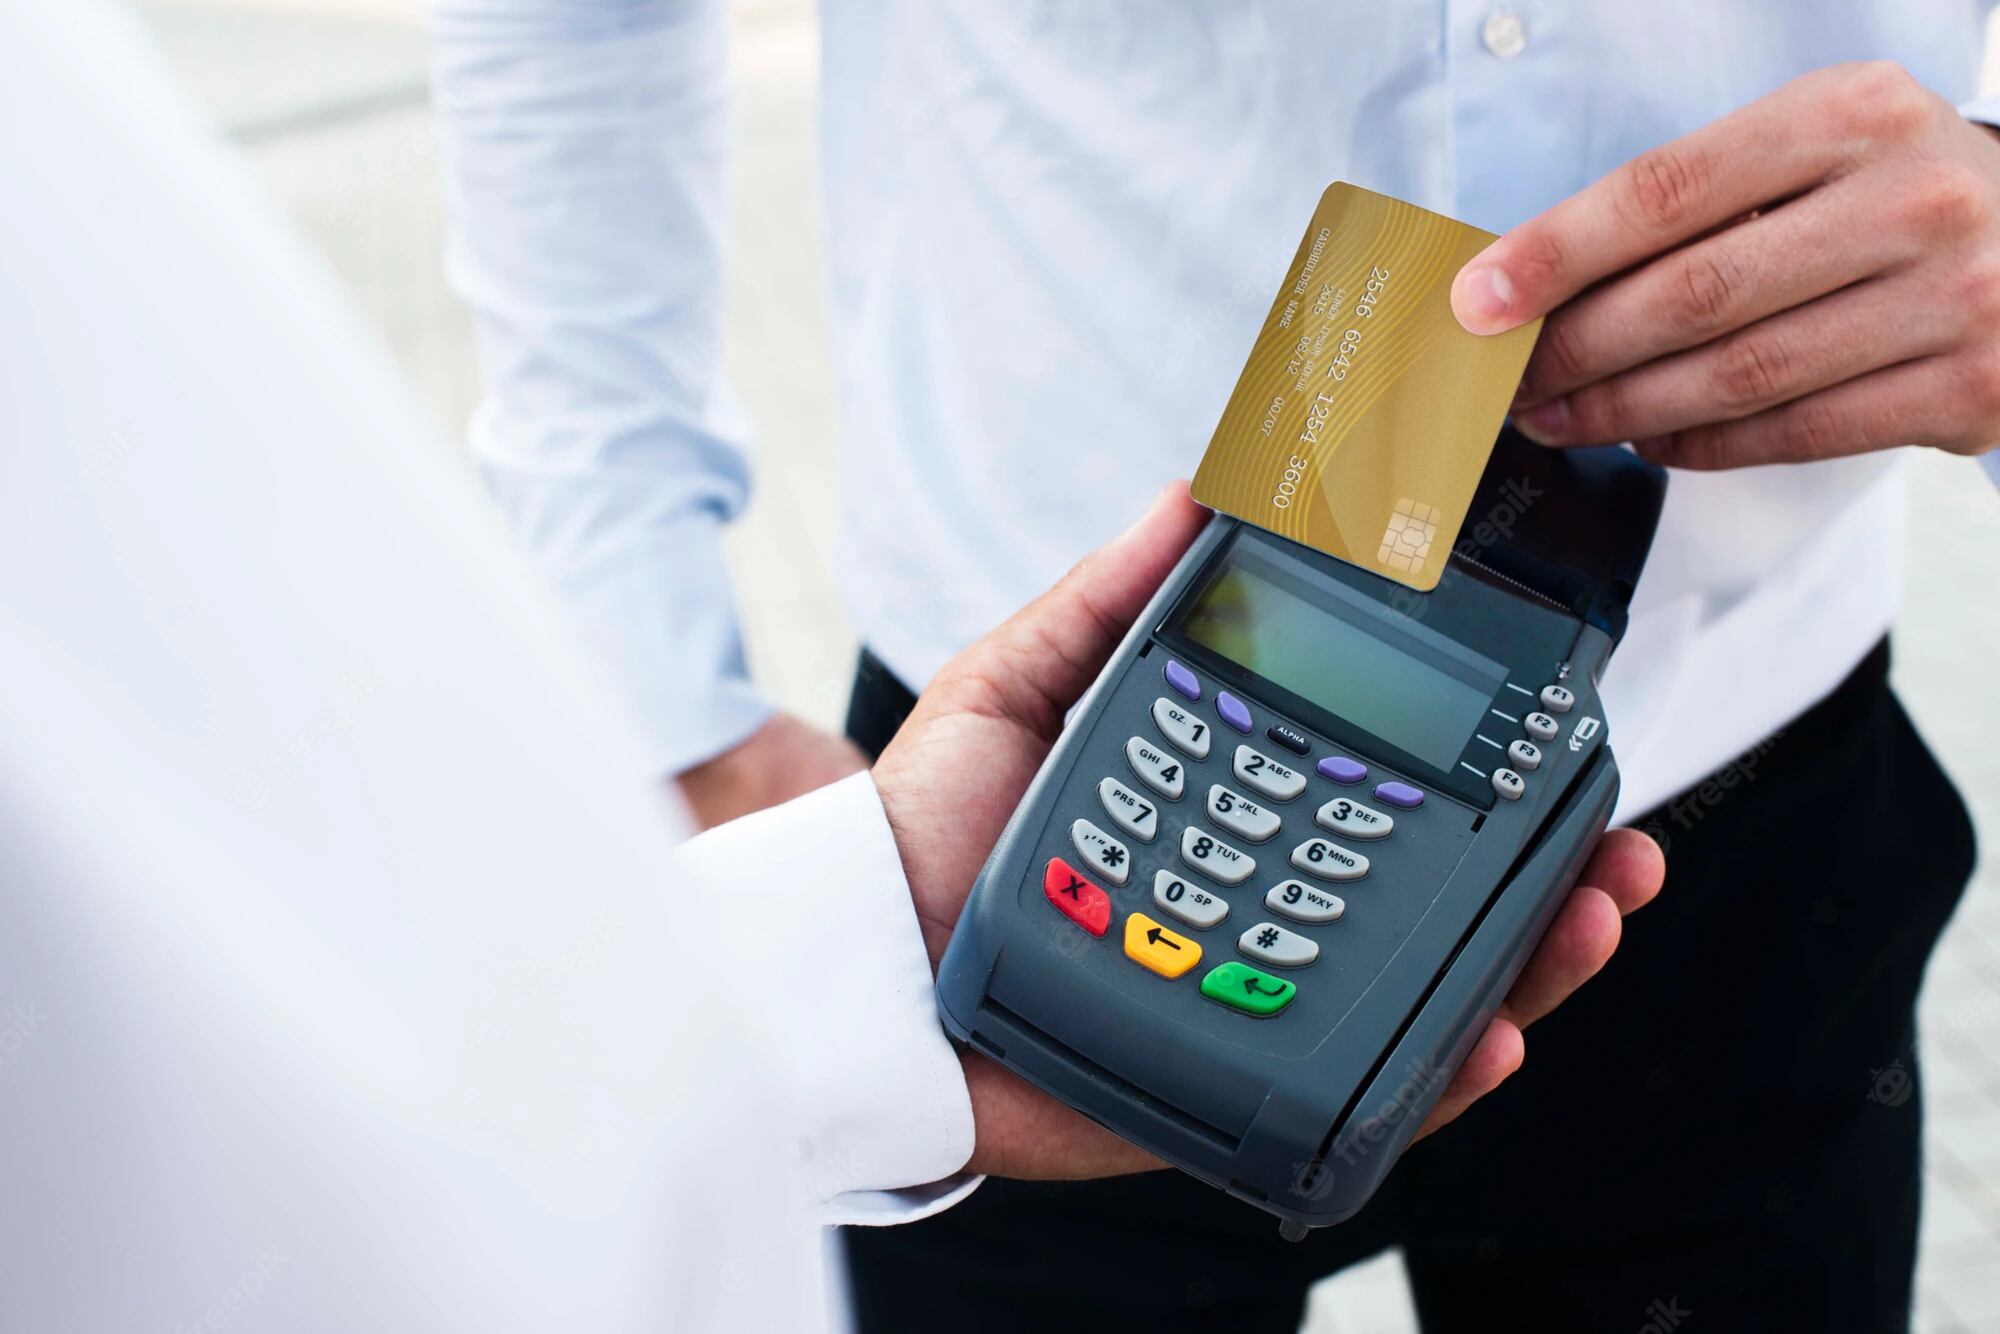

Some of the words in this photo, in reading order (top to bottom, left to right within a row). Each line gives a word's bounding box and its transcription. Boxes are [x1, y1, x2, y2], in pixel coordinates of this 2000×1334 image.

[1294, 227, 1330, 295] CARDHOLDER
[1313, 284, 1334, 315] 2015
[1355, 265, 1389, 319] 2546
[1279, 299, 1298, 329] NAME
[1286, 336, 1311, 375] 08/12
[1327, 328, 1361, 381] 6542
[1261, 396, 1285, 436] 00/07
[1300, 392, 1334, 444] 1254
[1272, 455, 1308, 509] 3600
[1552, 688, 1568, 700] F1
[1191, 724, 1205, 742] 1
[1534, 715, 1551, 728] F2
[1277, 726, 1305, 744] ALPHA
[1519, 743, 1535, 756] F3
[1139, 749, 1161, 764] GHI
[1160, 765, 1179, 783] 4
[1244, 754, 1265, 777] 2
[1267, 763, 1292, 779] ABC
[1502, 772, 1519, 786] F4
[1112, 789, 1135, 806] PRS
[1132, 803, 1153, 823] 7
[1215, 791, 1236, 813] 5
[1238, 801, 1259, 816] JKL
[1332, 801, 1352, 821] 3
[1355, 809, 1378, 825] DEF
[1192, 836, 1213, 859] 8
[1216, 845, 1241, 862] TUV
[1306, 842, 1327, 863] 6
[1328, 849, 1355, 868] MNO
[1165, 881, 1185, 902] 0
[1282, 883, 1303, 905] 9
[1307, 892, 1334, 910] WXY
